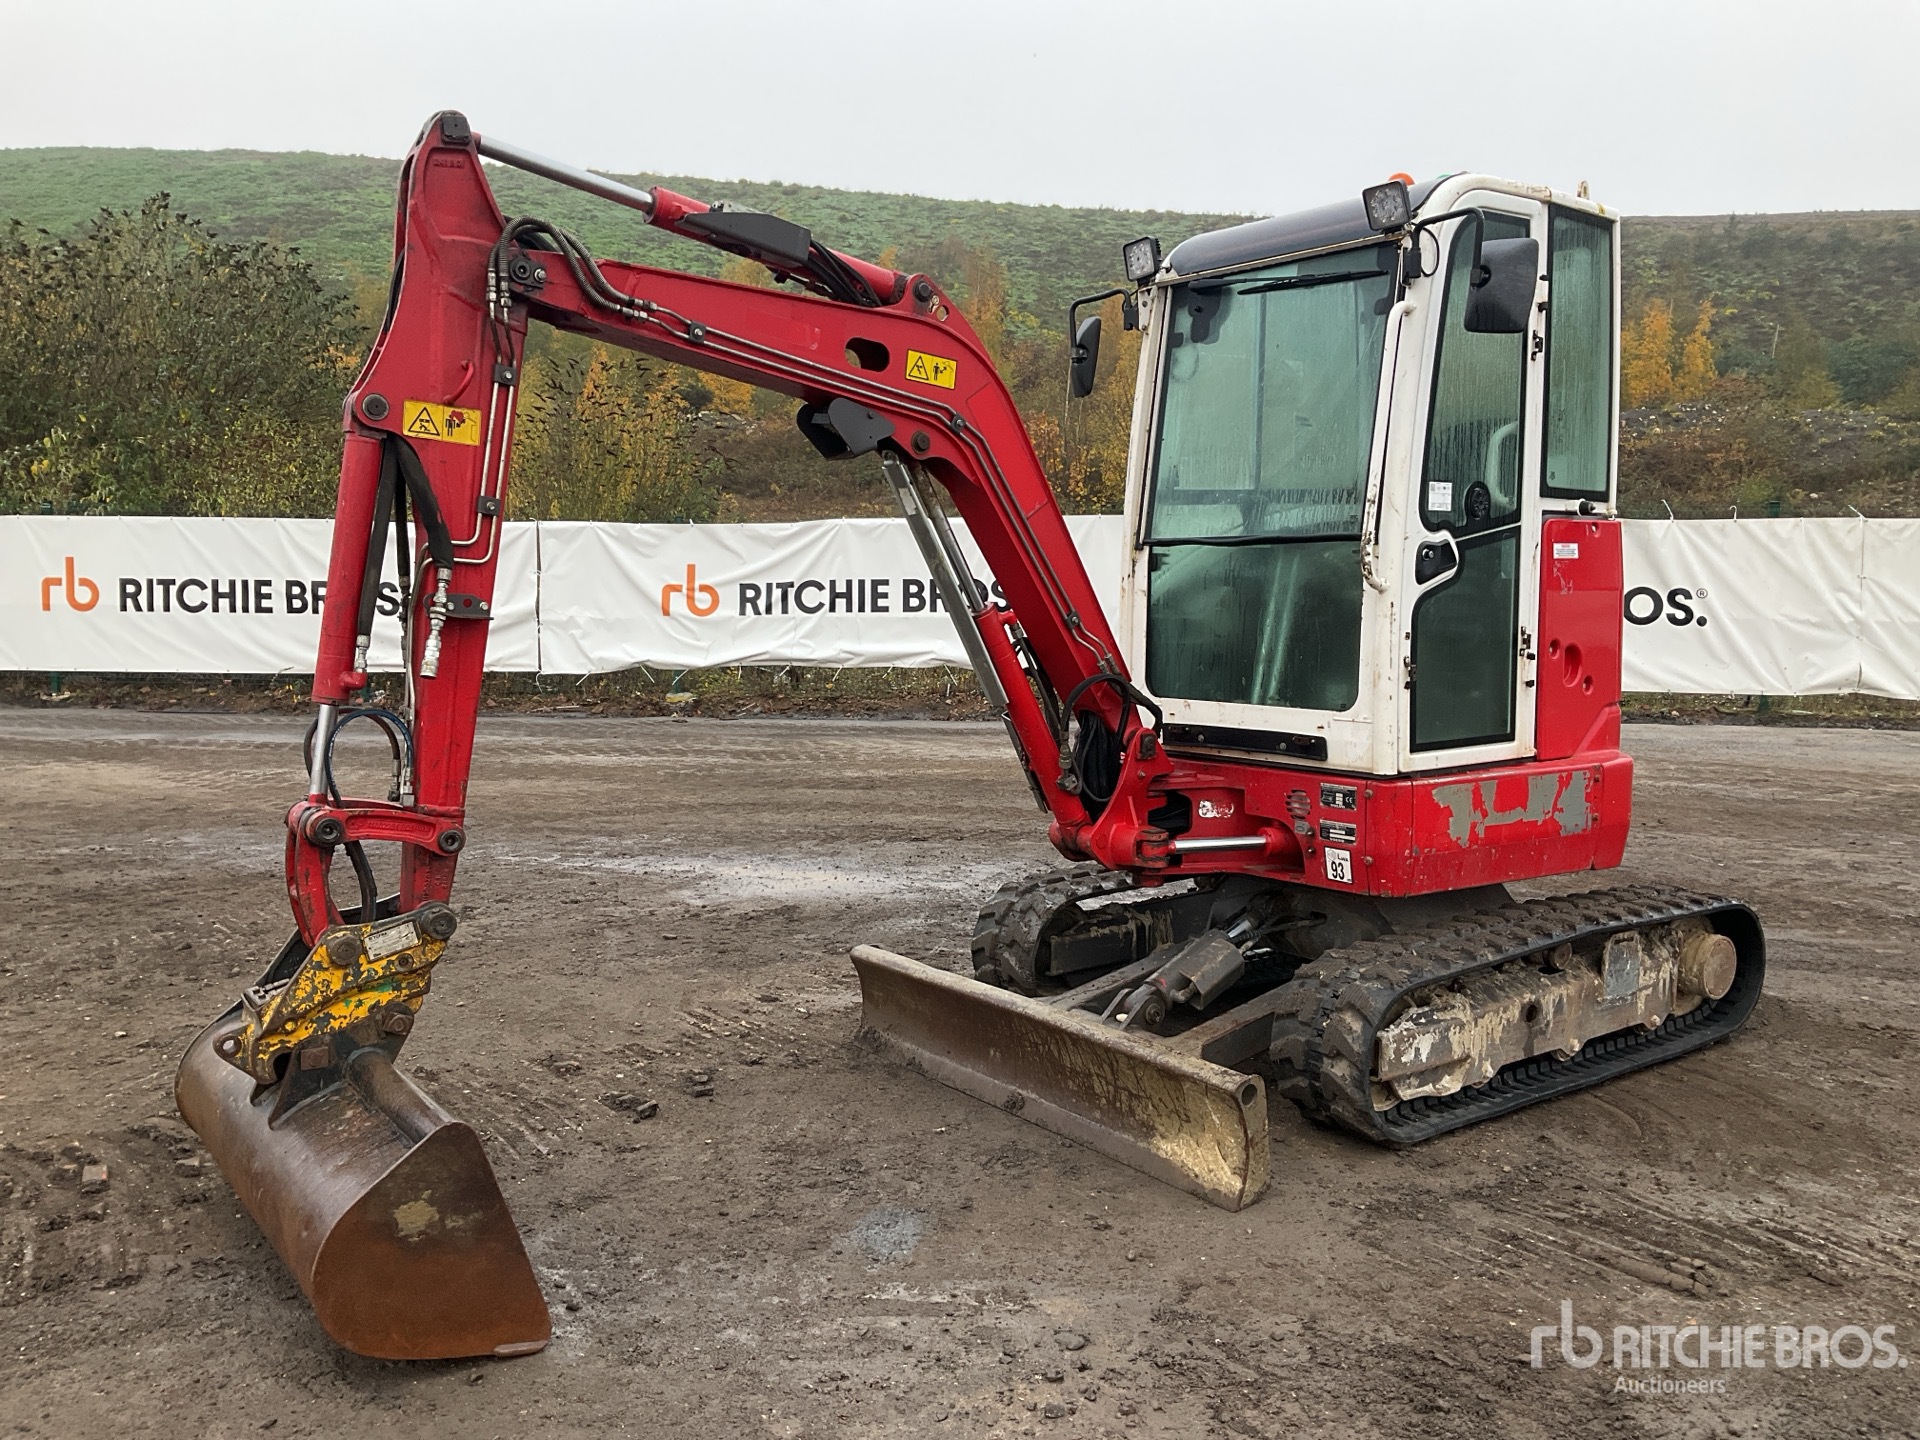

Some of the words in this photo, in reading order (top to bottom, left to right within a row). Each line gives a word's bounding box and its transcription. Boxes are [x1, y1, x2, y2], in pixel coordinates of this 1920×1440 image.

[119, 578, 274, 614] RITCHIE
[285, 579, 400, 617] BRS
[739, 579, 890, 616] RITCHIE
[1331, 860, 1345, 881] 93
